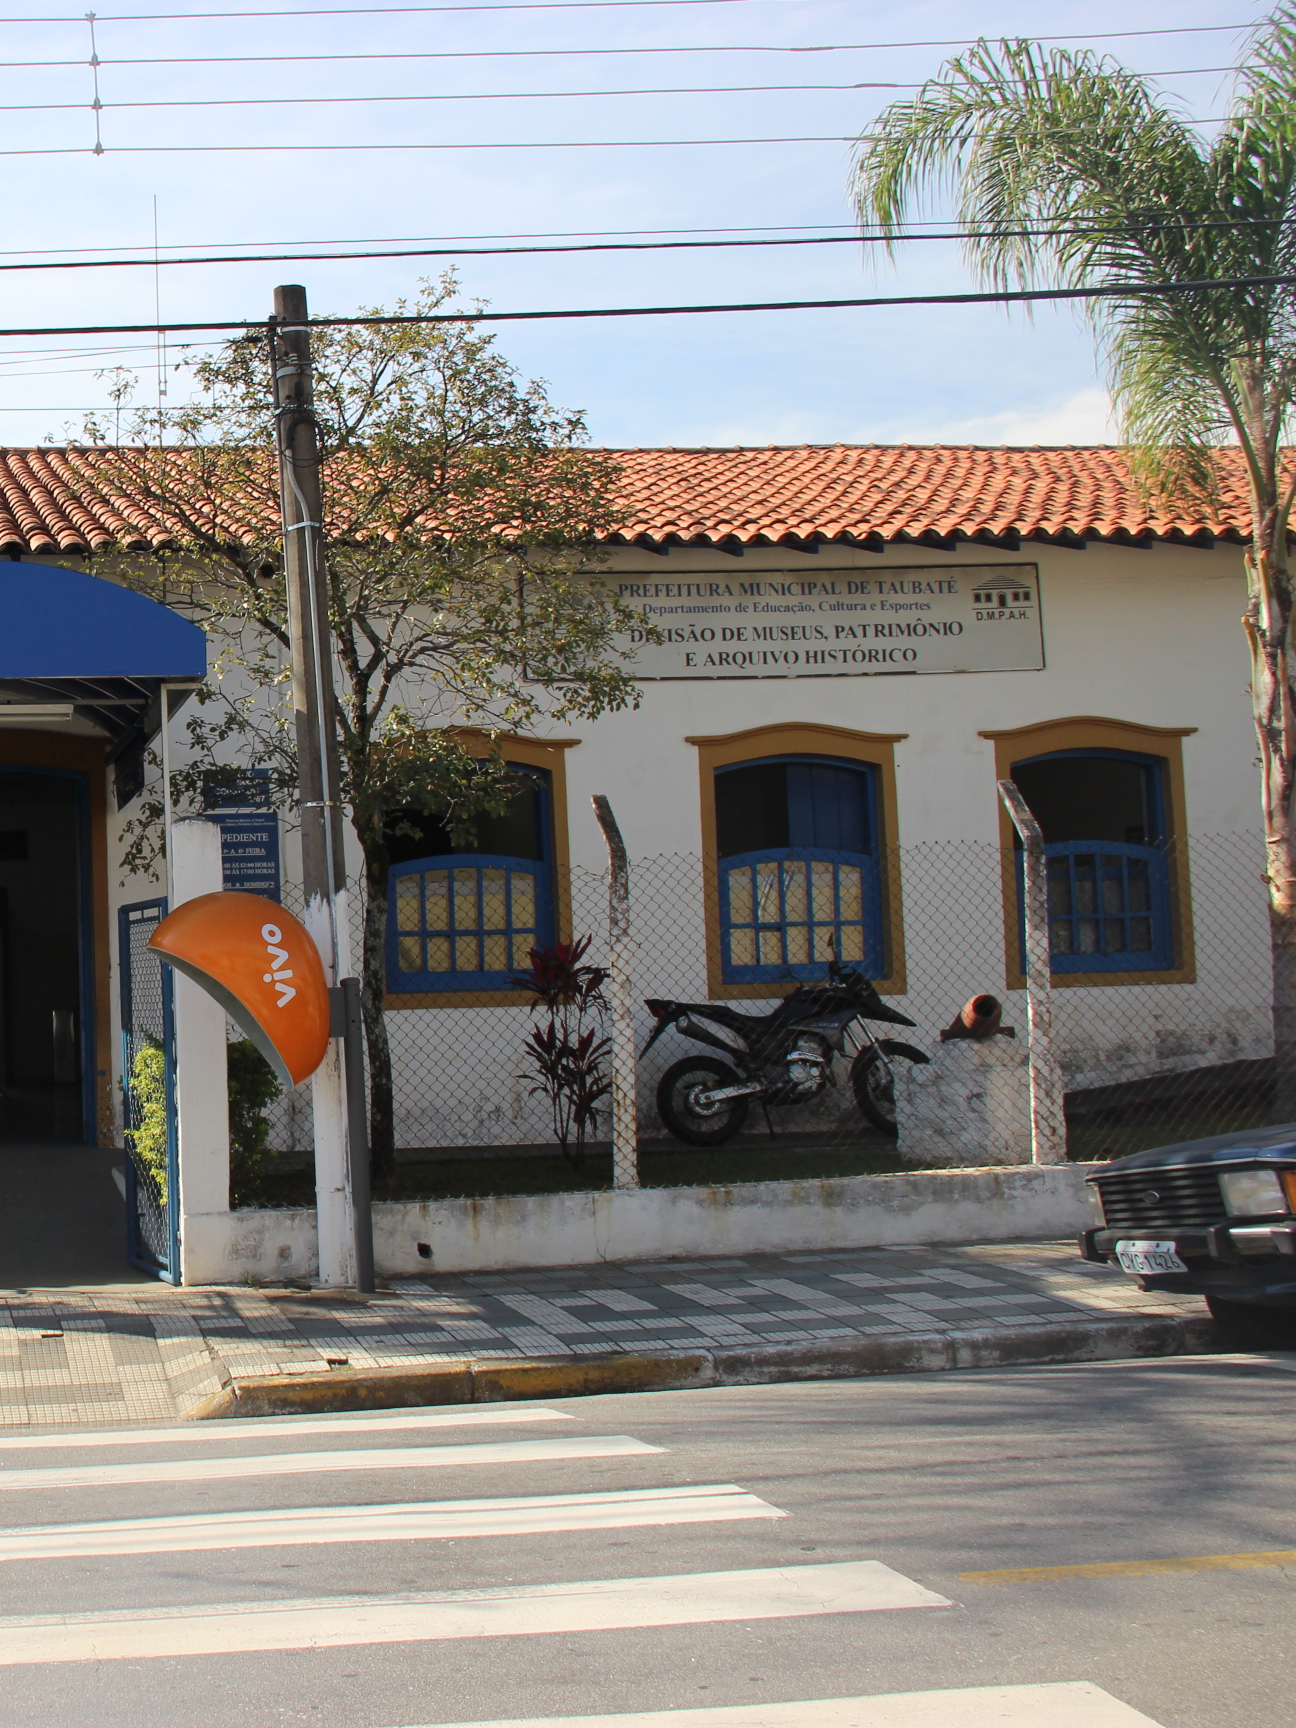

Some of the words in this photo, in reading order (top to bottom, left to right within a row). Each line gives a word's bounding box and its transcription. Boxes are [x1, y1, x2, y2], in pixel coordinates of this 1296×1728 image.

[618, 583, 734, 598] PREFEITURA
[739, 581, 842, 597] MUNICIPAL
[847, 580, 871, 595] DE
[875, 576, 958, 595] TAUBATÉ
[643, 603, 731, 617] Departamento
[734, 602, 749, 613] de
[753, 601, 816, 615] Educação,
[818, 600, 867, 612] Cultura
[870, 603, 877, 611] e
[880, 600, 931, 614] Esportes
[976, 610, 1030, 622] D.M.P.A.H.
[721, 626, 748, 642] DE
[752, 625, 829, 642] MUSEUS,
[834, 618, 963, 640] PATRIMÔNIO
[685, 652, 697, 667] E
[703, 650, 799, 669] ARQUIVO
[804, 644, 917, 665] HISTÓRICO
[221, 833, 269, 842] PEDIENTE
[261, 923, 297, 1008] vivo
